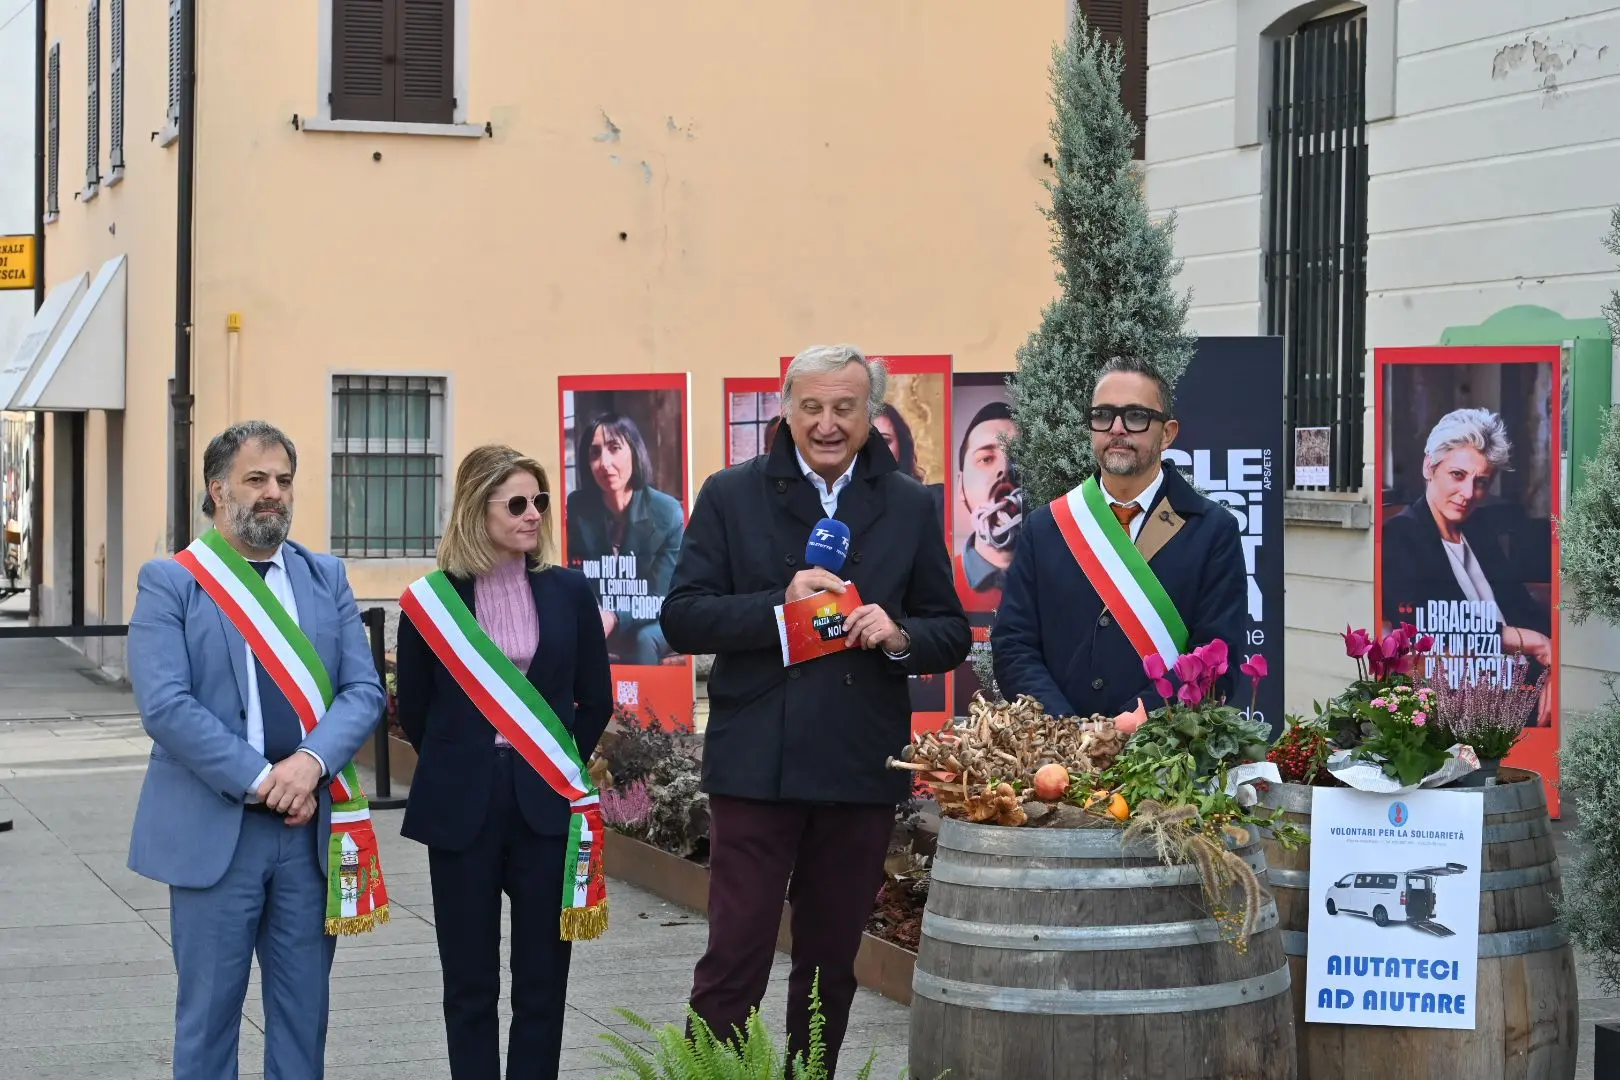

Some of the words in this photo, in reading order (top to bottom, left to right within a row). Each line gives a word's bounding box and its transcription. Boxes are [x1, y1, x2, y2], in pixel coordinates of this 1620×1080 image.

[0, 244, 25, 254] NALE
[1263, 448, 1272, 490] APS/ETS
[582, 560, 601, 579] NON
[601, 555, 617, 579] HO
[618, 550, 637, 580] PIÙ
[600, 579, 607, 595] IL
[607, 579, 648, 596] CONTROLLO
[602, 595, 616, 612] DEL
[616, 595, 631, 612] MIO
[813, 616, 830, 627] PIAZZA
[1416, 606, 1427, 632] IL
[1427, 600, 1497, 633] BRACCIO
[827, 624, 842, 638] NOI
[1448, 633, 1464, 657] UN
[1467, 633, 1501, 657] PEZZO
[1330, 827, 1376, 837] VOLONTARI
[1379, 828, 1395, 838] PER
[1398, 829, 1408, 838] LA
[1410, 829, 1465, 841] SOLIDARIETÀ
[1327, 954, 1459, 981] AIUTATECI
[1317, 987, 1355, 1010] AD
[1362, 989, 1466, 1015] AIUTARE
